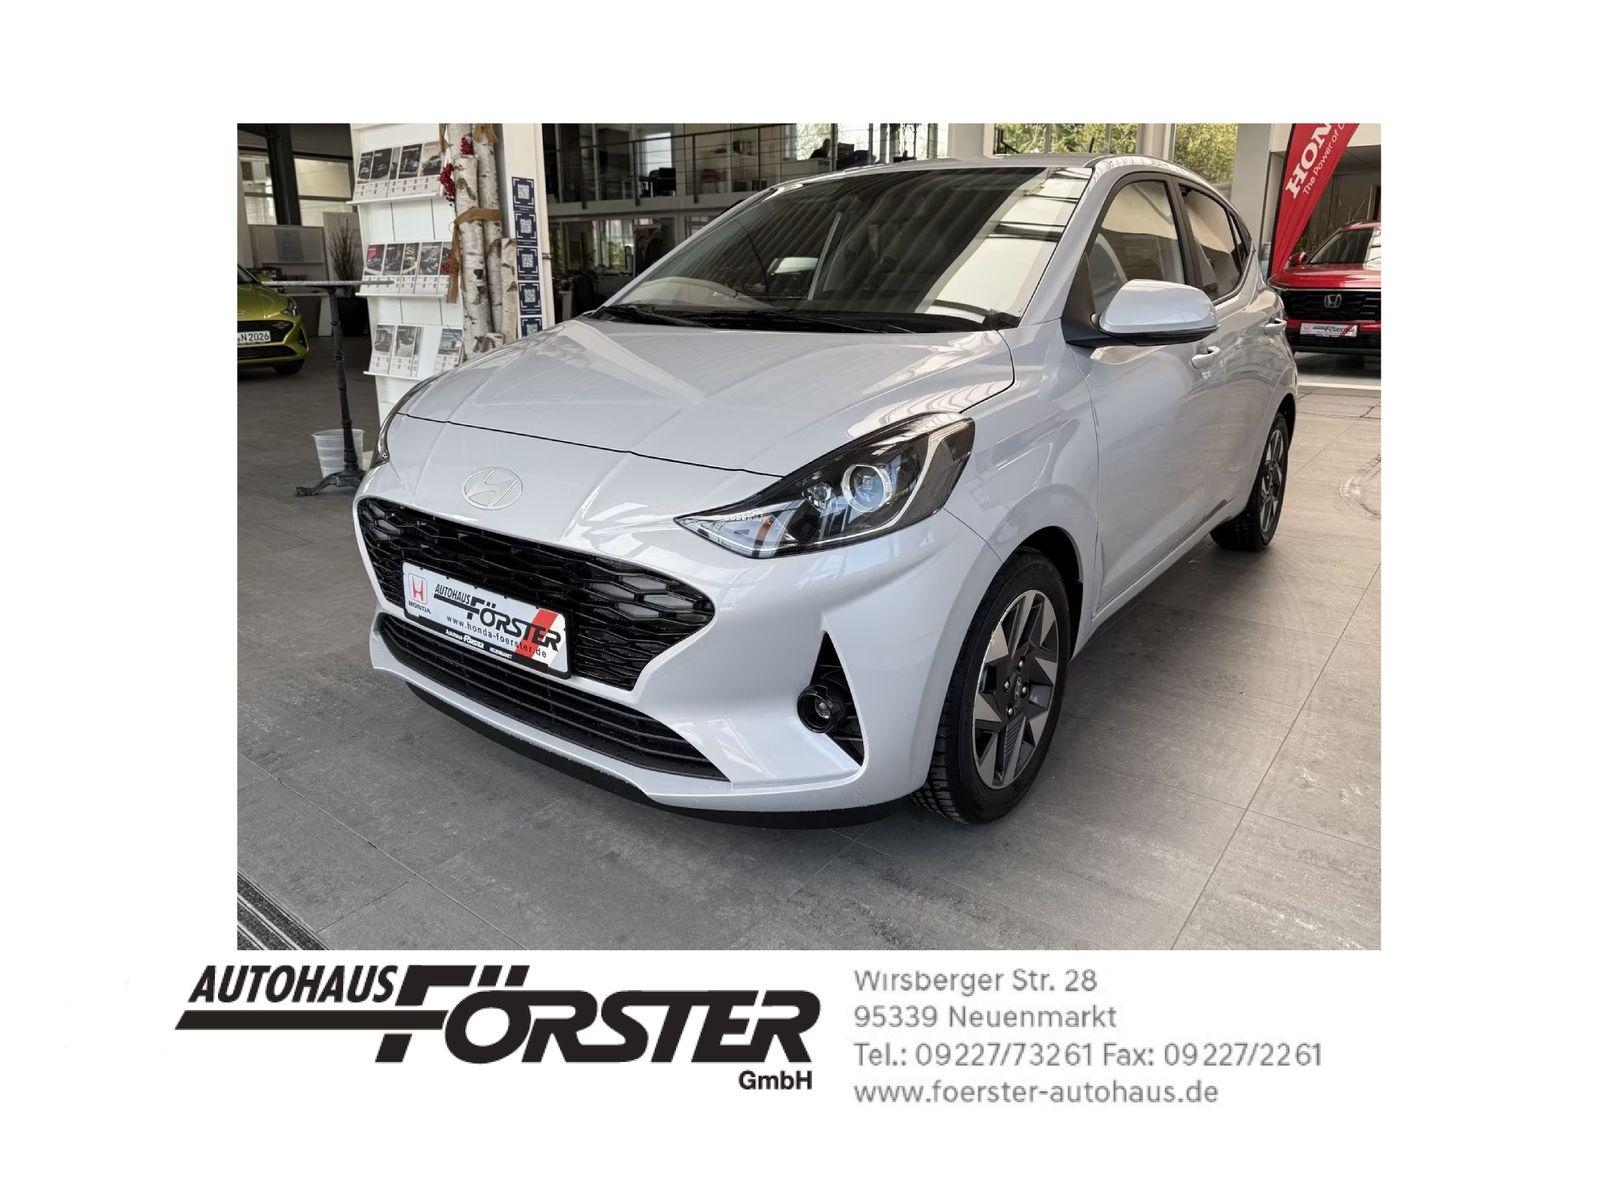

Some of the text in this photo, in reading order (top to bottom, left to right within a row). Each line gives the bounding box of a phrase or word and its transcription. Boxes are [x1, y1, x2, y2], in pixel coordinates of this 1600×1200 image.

[1302, 176, 1317, 195] The
[1312, 144, 1333, 176] Power
[1331, 129, 1340, 143] of
[434, 583, 562, 652] AUTOHAUS FÖRSTER
[446, 614, 547, 659] www.honda-foerster.de
